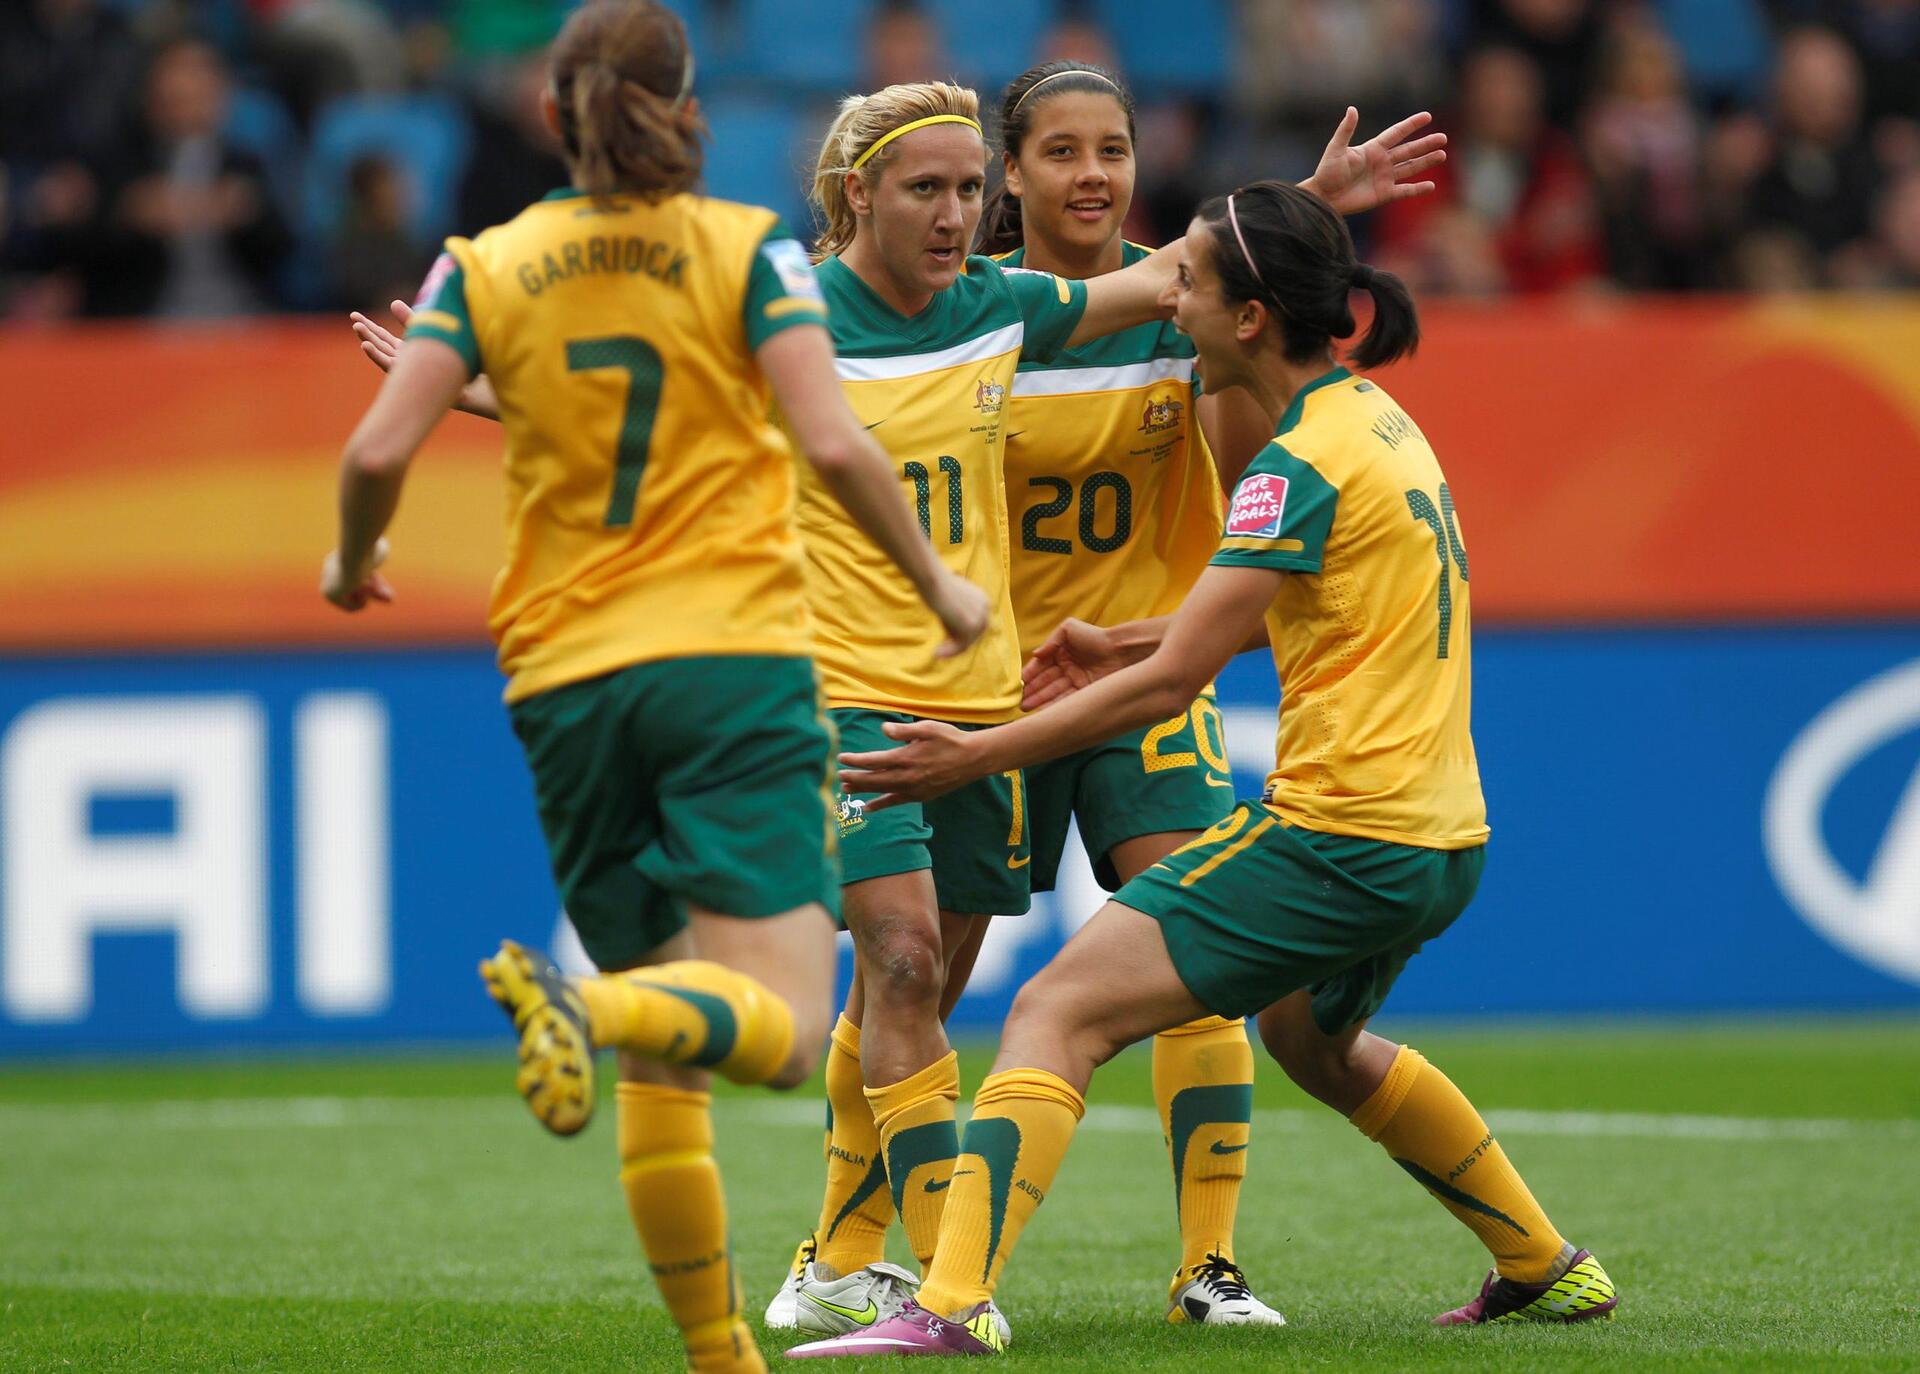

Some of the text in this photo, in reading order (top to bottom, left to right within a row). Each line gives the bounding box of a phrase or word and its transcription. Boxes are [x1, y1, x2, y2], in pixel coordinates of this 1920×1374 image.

[517, 236, 690, 297] GARRIOCK
[565, 333, 665, 528] 7
[904, 455, 963, 545] 11
[1021, 470, 1132, 556] 20
[1141, 697, 1231, 775] 20
[0, 688, 390, 1022] AI
